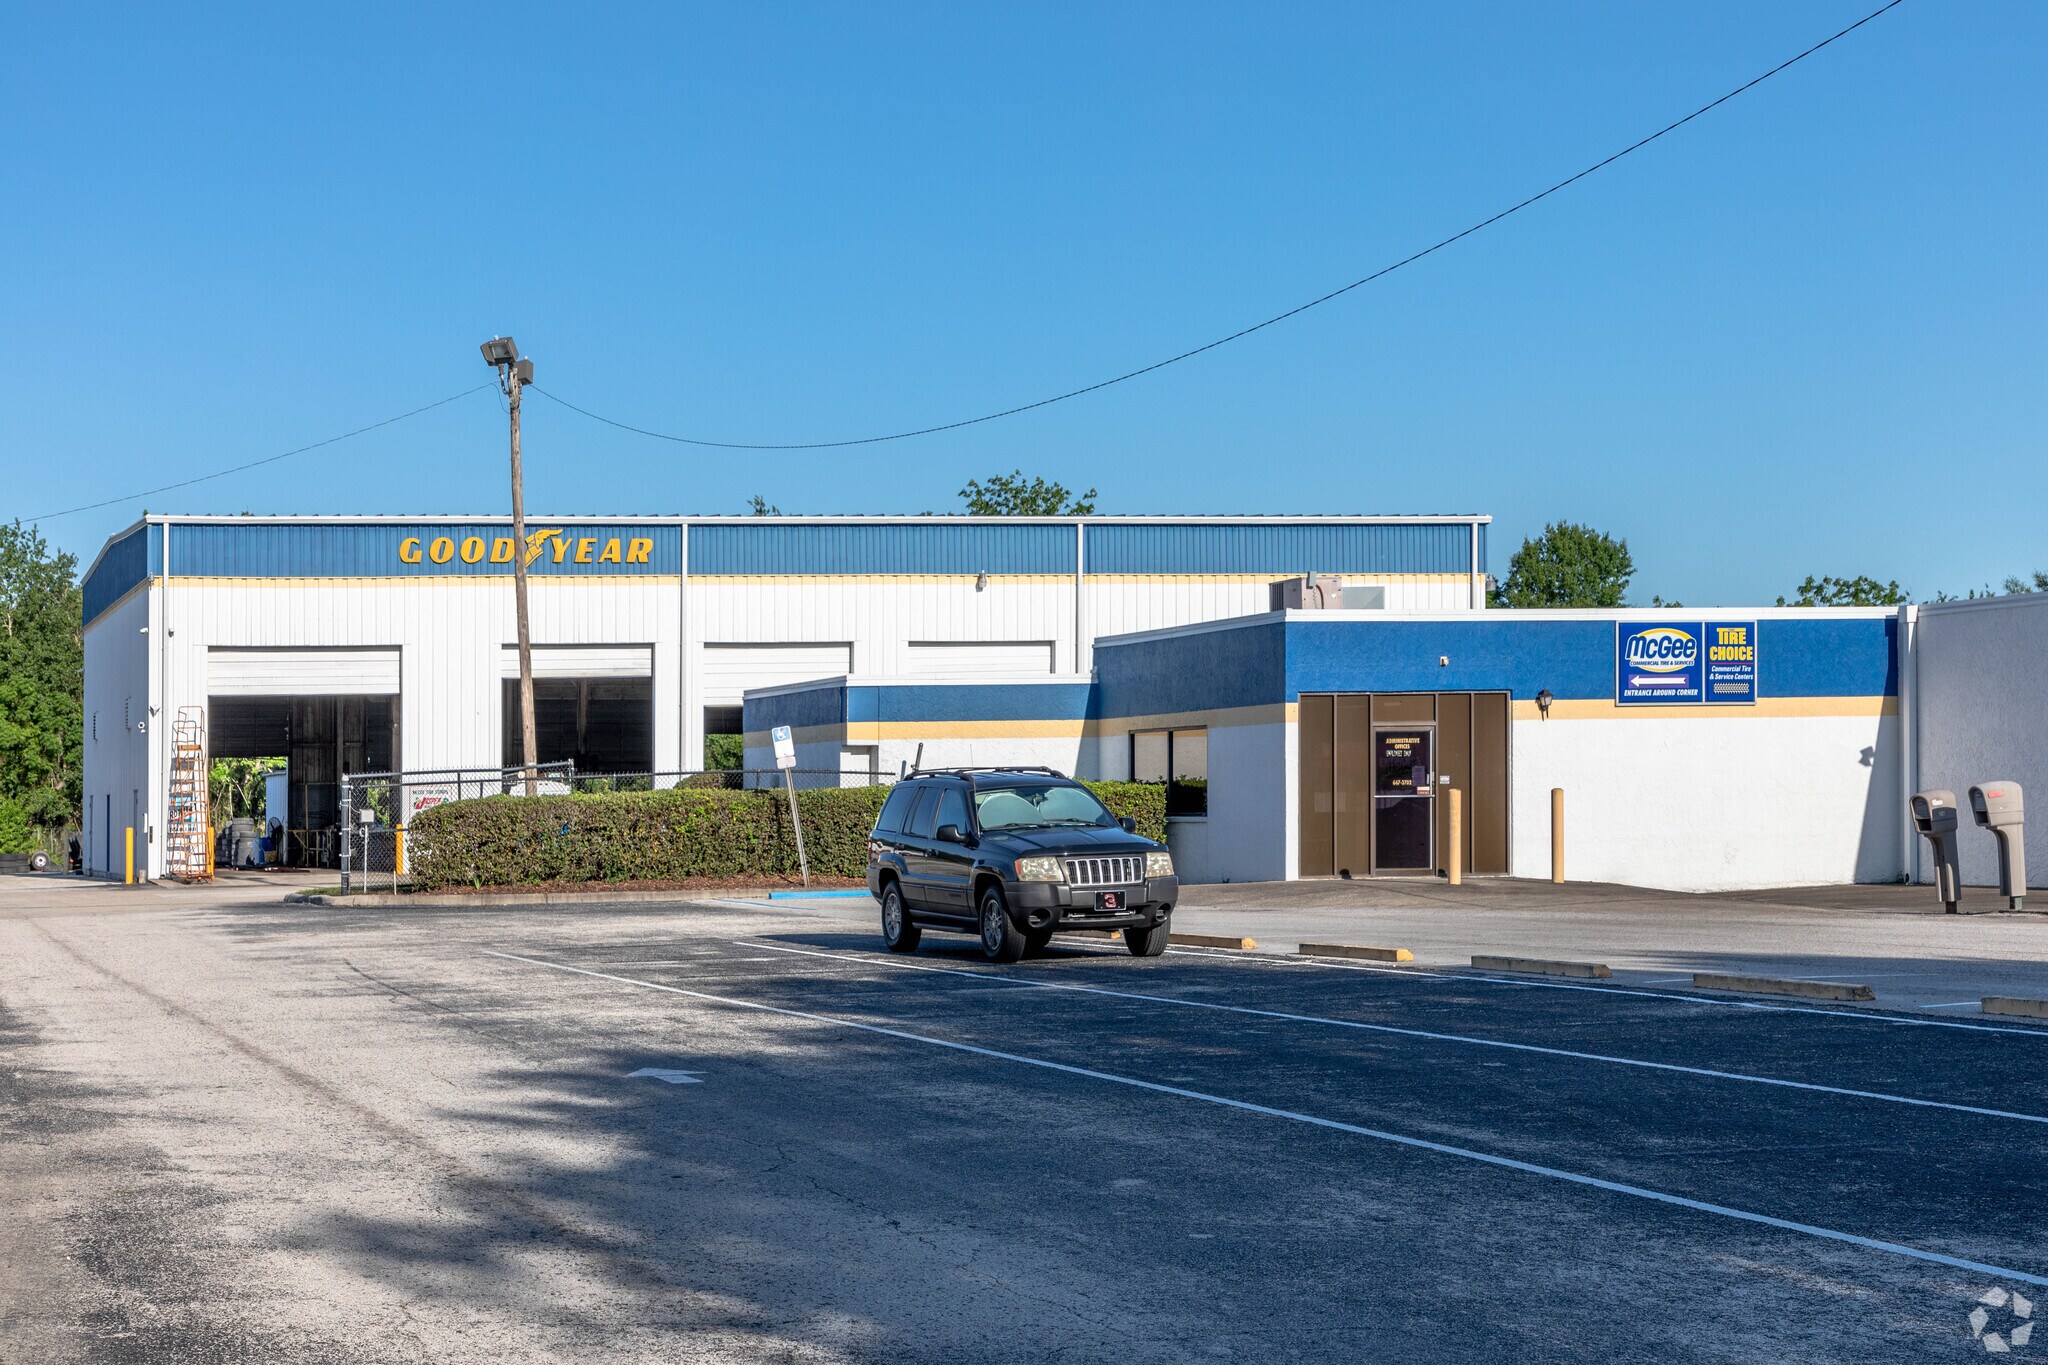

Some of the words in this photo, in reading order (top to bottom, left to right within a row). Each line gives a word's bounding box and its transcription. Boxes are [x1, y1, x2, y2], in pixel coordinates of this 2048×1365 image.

[1716, 627, 1747, 645] TIRE
[1709, 646, 1754, 661] CHOICE
[1624, 689, 1652, 697] ENTRANCE
[1677, 688, 1699, 696] CORNER
[1104, 893, 1117, 908] 3
